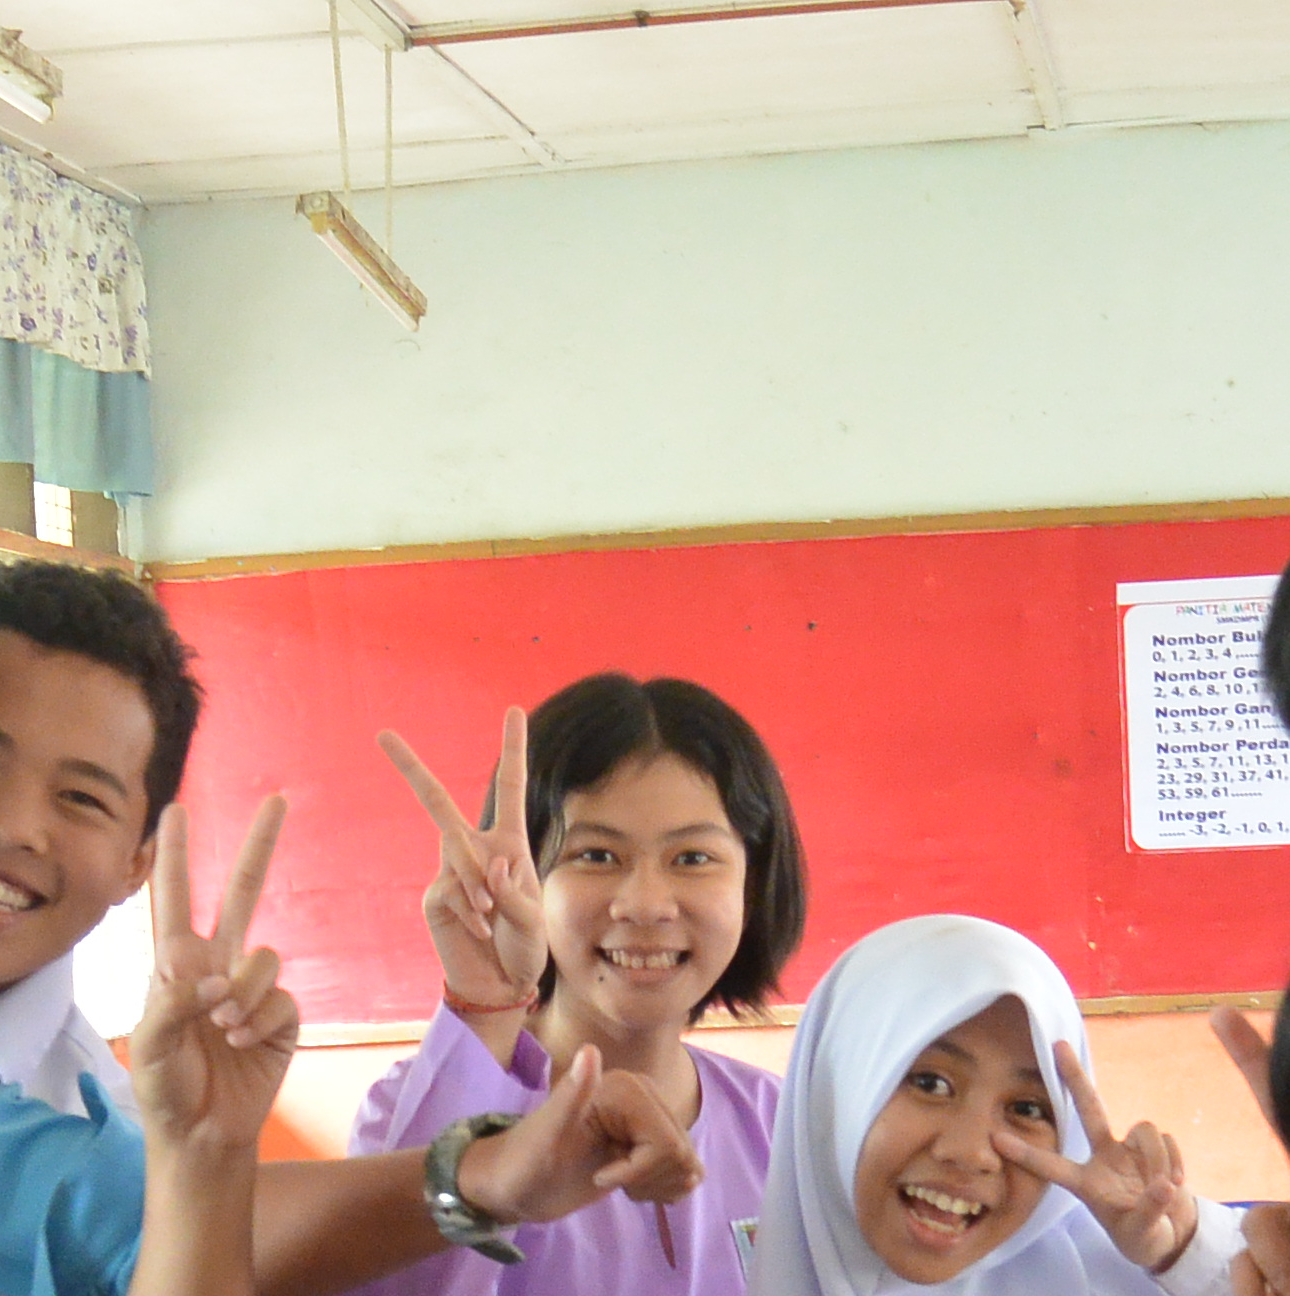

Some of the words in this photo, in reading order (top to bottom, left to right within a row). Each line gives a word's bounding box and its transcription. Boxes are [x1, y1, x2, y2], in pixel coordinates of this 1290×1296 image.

[1175, 603, 1228, 615] PANITIA
[1233, 601, 1271, 613] MATE
[1152, 632, 1226, 647] Nombor
[1152, 650, 1166, 663] 0,
[1171, 649, 1183, 662] 1,
[1187, 648, 1201, 661] 2,
[1205, 647, 1218, 660] 3,
[1222, 647, 1232, 659] 4
[1154, 668, 1227, 683] Nombor
[1154, 687, 1167, 698] 2,
[1171, 686, 1184, 698] 4,
[1189, 685, 1202, 697] 6,
[1206, 684, 1220, 696] 8,
[1155, 705, 1229, 719] Nombor
[1157, 723, 1169, 735] 1,
[1173, 722, 1186, 734] 3,
[1190, 721, 1203, 733] 5,
[1208, 720, 1221, 732] 7,
[1156, 741, 1230, 755] Nombor
[1157, 758, 1170, 770] 2,
[1174, 758, 1187, 769] 3,
[1192, 757, 1205, 769] 5,
[1209, 757, 1222, 768] 7,
[1228, 755, 1249, 767] 11,
[1255, 754, 1277, 766] 13,
[1157, 774, 1180, 785] 23,
[1184, 772, 1207, 784] 29,
[1211, 771, 1234, 783] 31,
[1238, 770, 1261, 782] 37,
[1265, 769, 1288, 781] 41,
[1158, 788, 1181, 800] 53,
[1184, 787, 1208, 799] 59,
[1159, 809, 1226, 823] Integer
[1258, 822, 1272, 833] 0,
[1277, 821, 1289, 832] 1,
